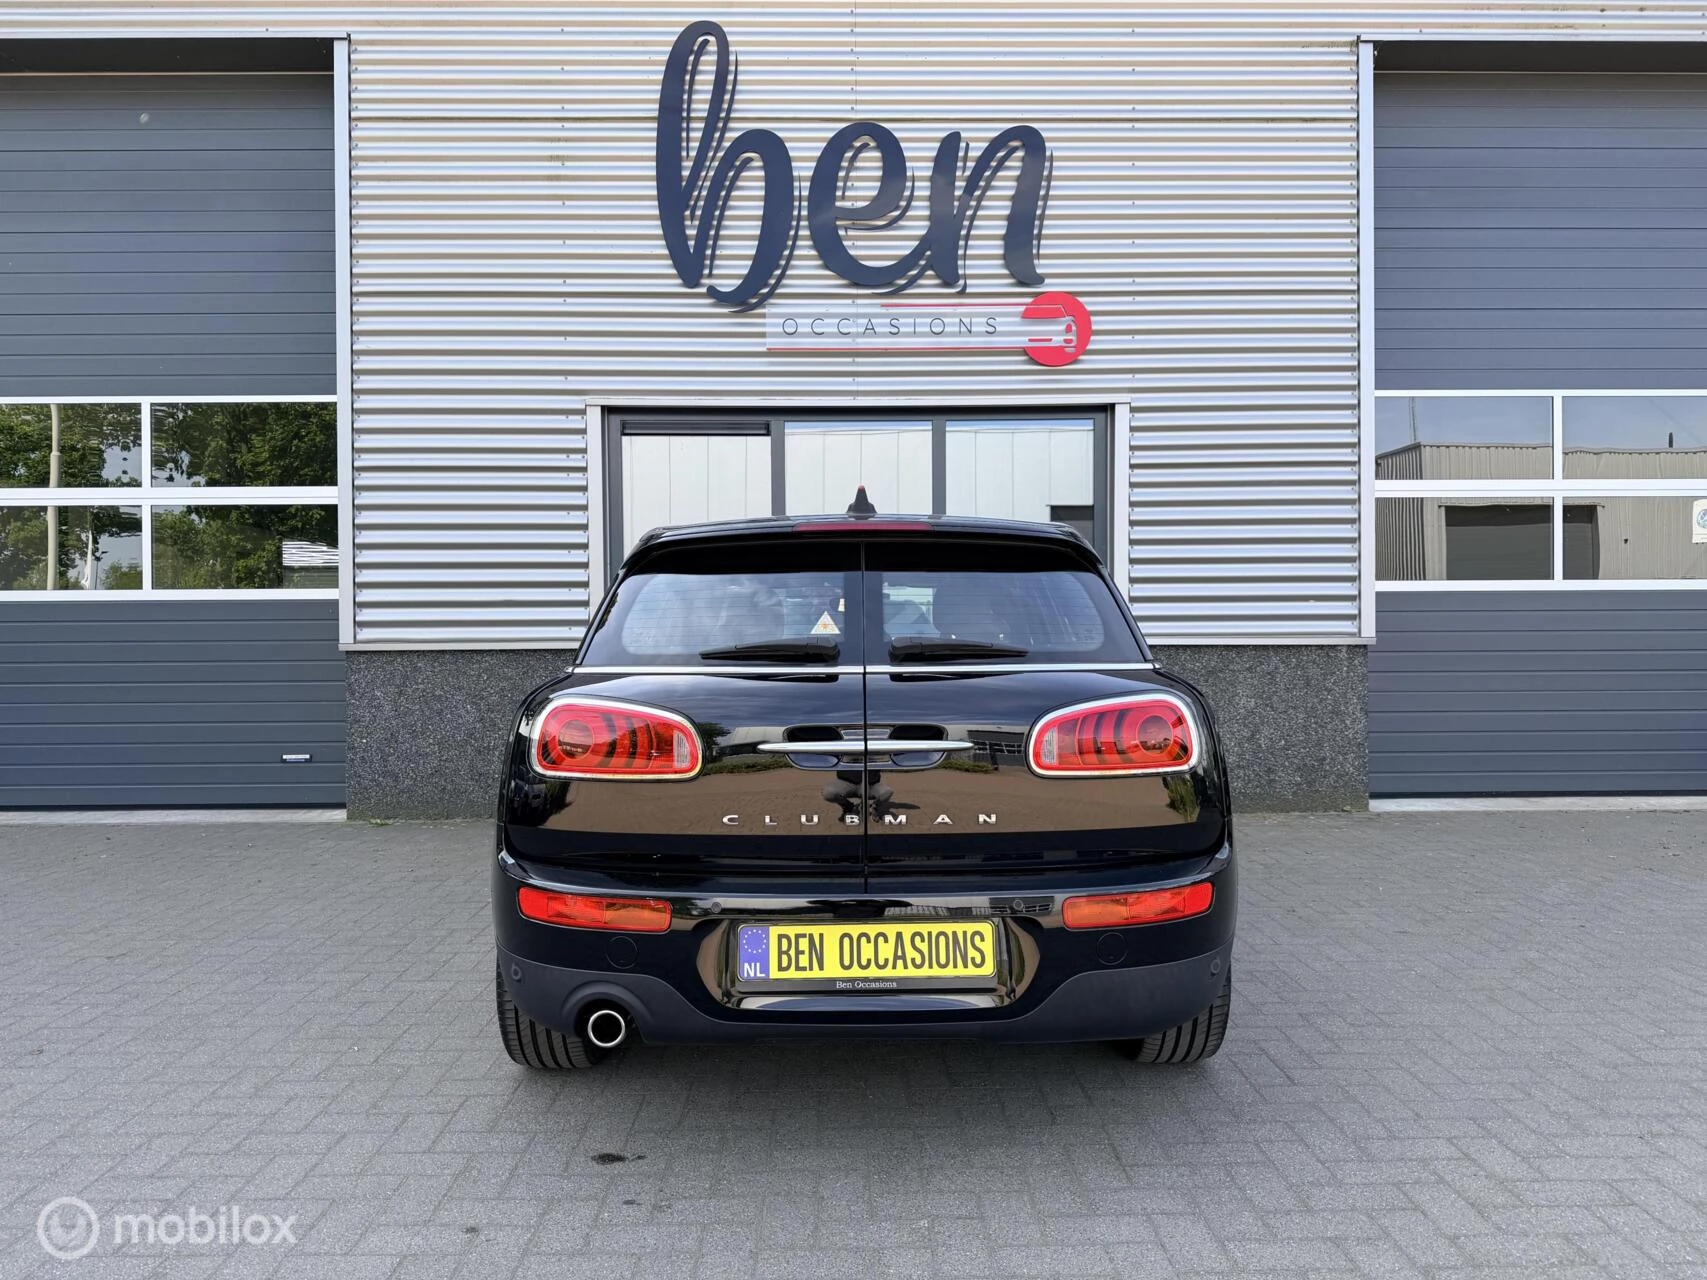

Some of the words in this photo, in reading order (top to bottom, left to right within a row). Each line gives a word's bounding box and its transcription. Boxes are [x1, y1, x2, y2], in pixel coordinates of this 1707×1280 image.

[656, 20, 1053, 312] ben
[782, 316, 997, 336] OCCASIONS
[722, 814, 997, 825] CLUBMAN
[777, 933, 824, 972] BEN
[839, 930, 986, 970] OCCASIONS
[744, 963, 766, 978] NL
[836, 981, 852, 989] Ben
[854, 980, 897, 989] Occasions
